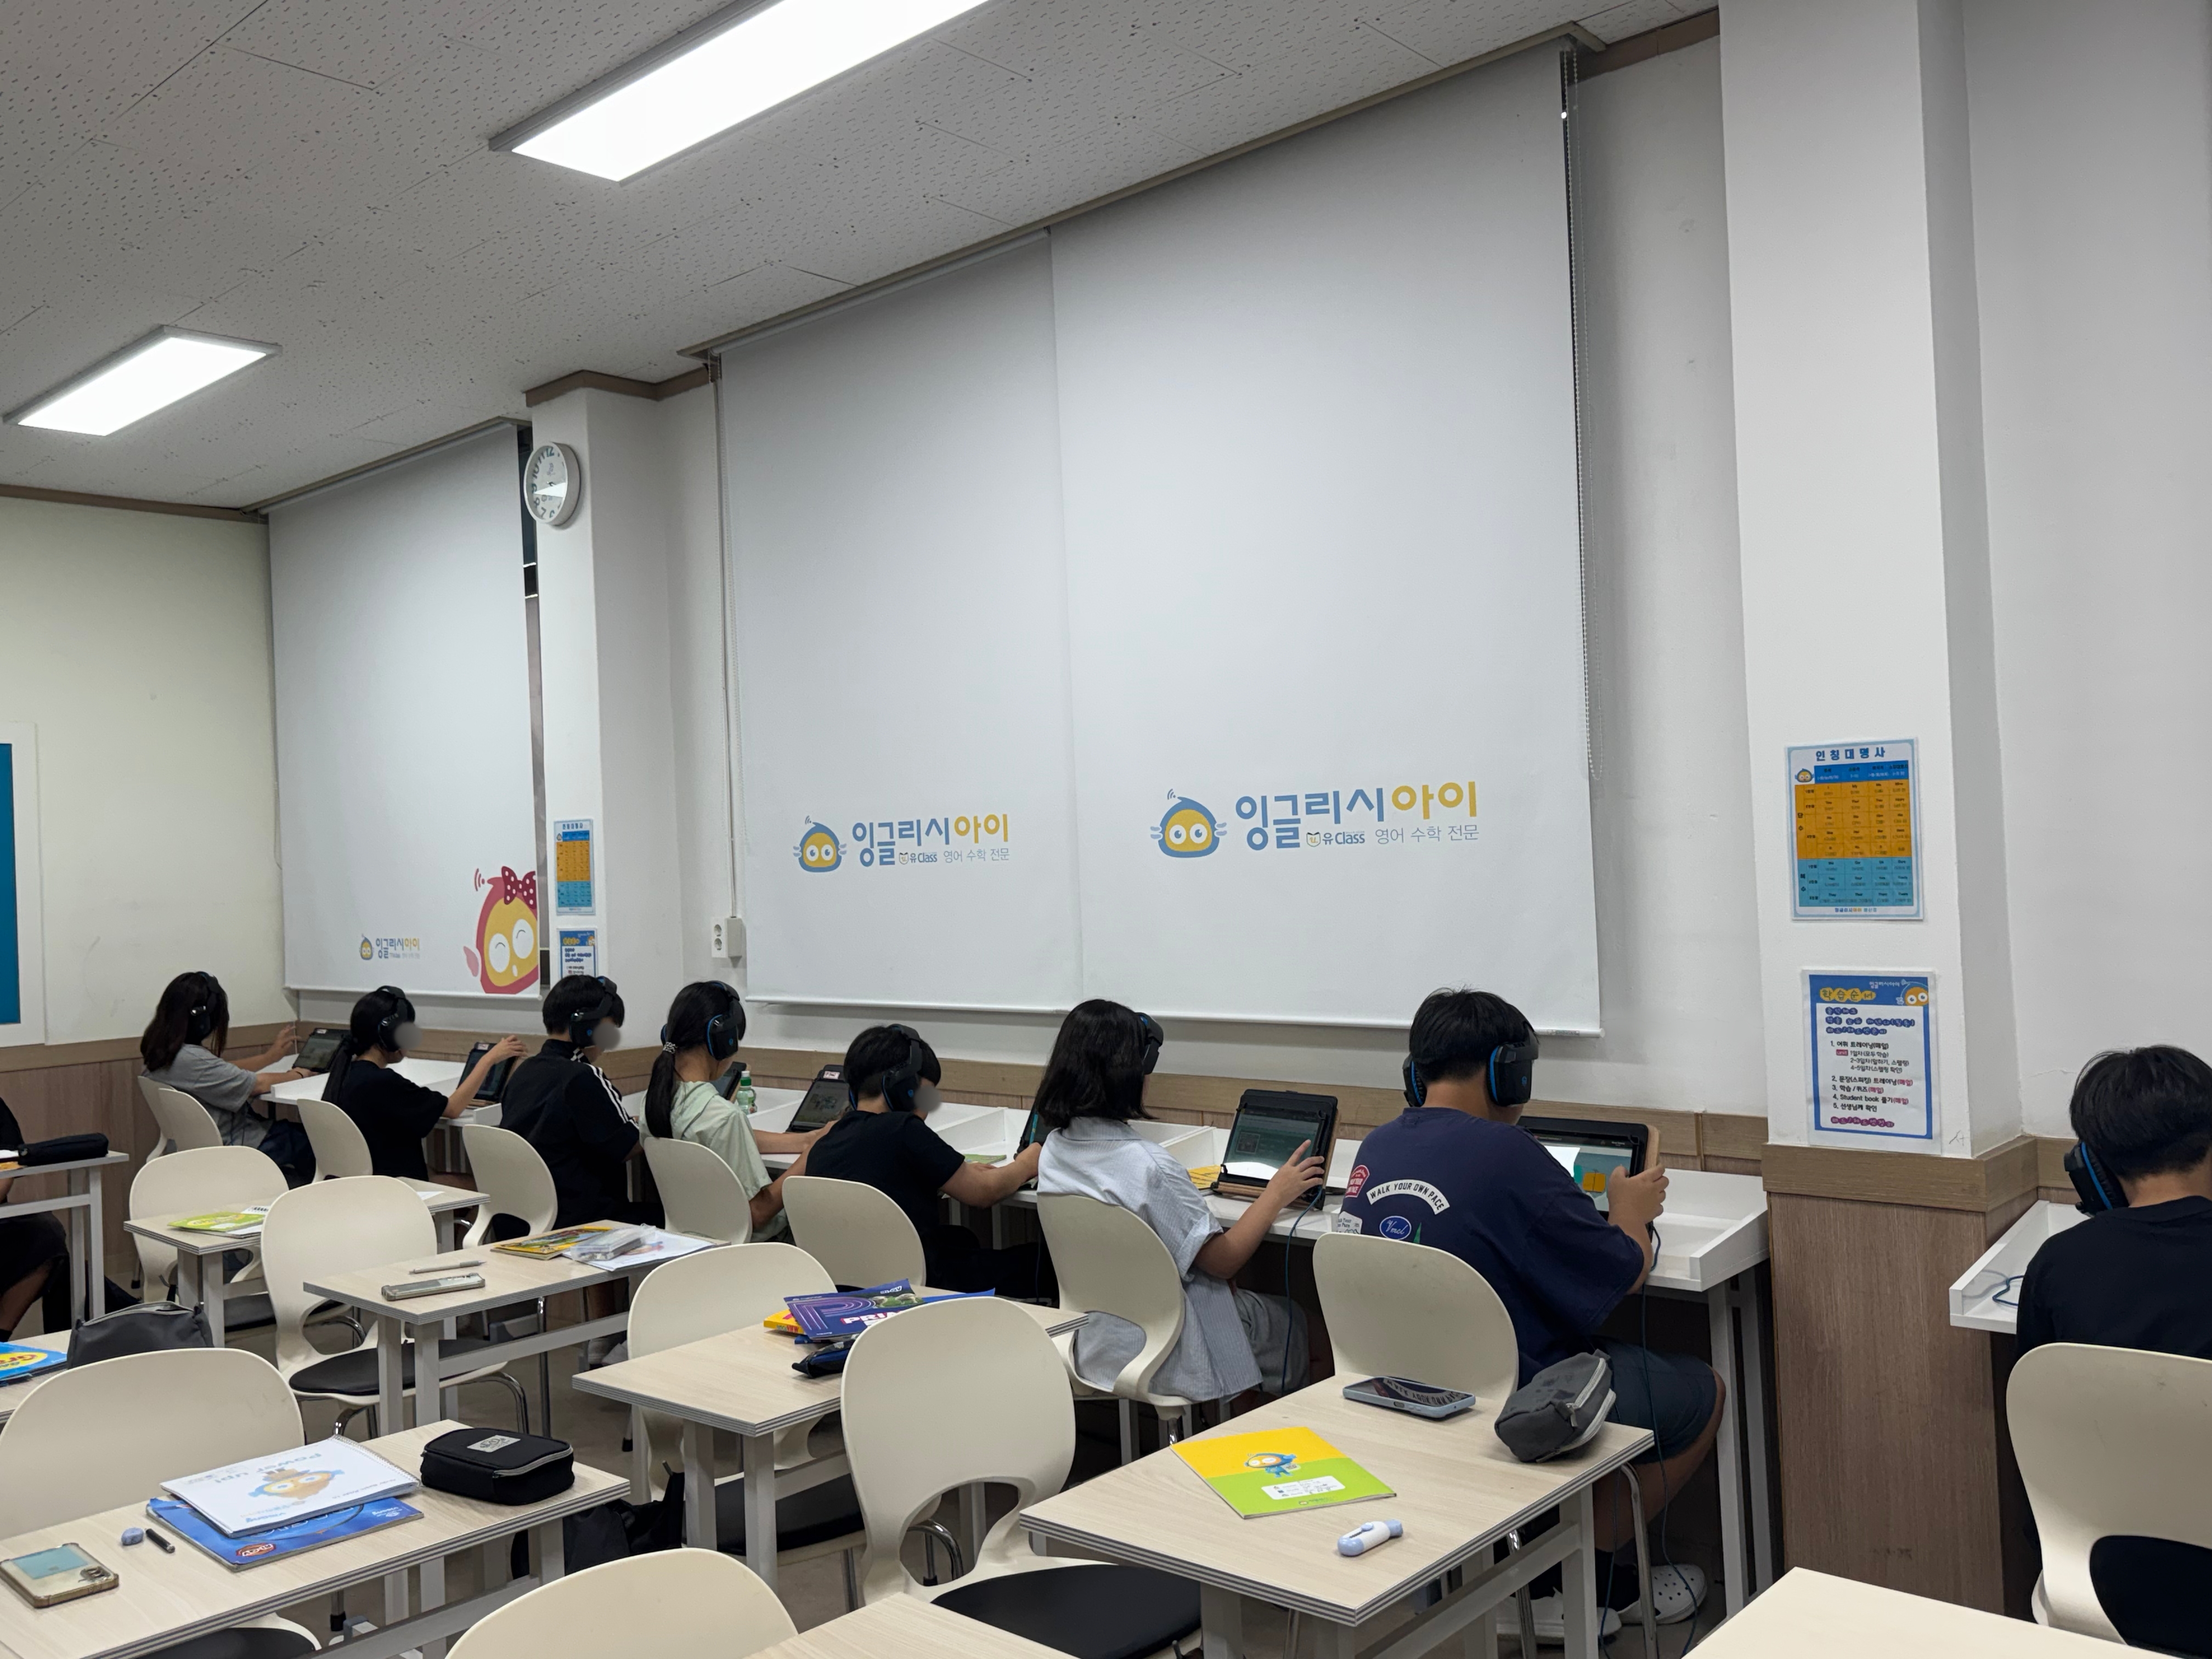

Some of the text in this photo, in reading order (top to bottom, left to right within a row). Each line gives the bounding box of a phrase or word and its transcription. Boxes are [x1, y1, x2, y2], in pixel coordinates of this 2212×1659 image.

[546, 447, 555, 457] 12
[1235, 781, 1477, 850] 잉글리시아이
[852, 814, 1008, 867] 잉글리시아이
[1375, 828, 1404, 844] 영어
[1410, 826, 1442, 843] 수학
[1448, 825, 1479, 841] 전문
[944, 850, 962, 864] 영어
[967, 849, 986, 862] 수학
[990, 848, 1010, 861] 전문
[376, 938, 420, 959] 잉글리시아이
[1822, 989, 1874, 1001] 학습순서
[1370, 1182, 1444, 1211] WALK YOUR OWN PACE
